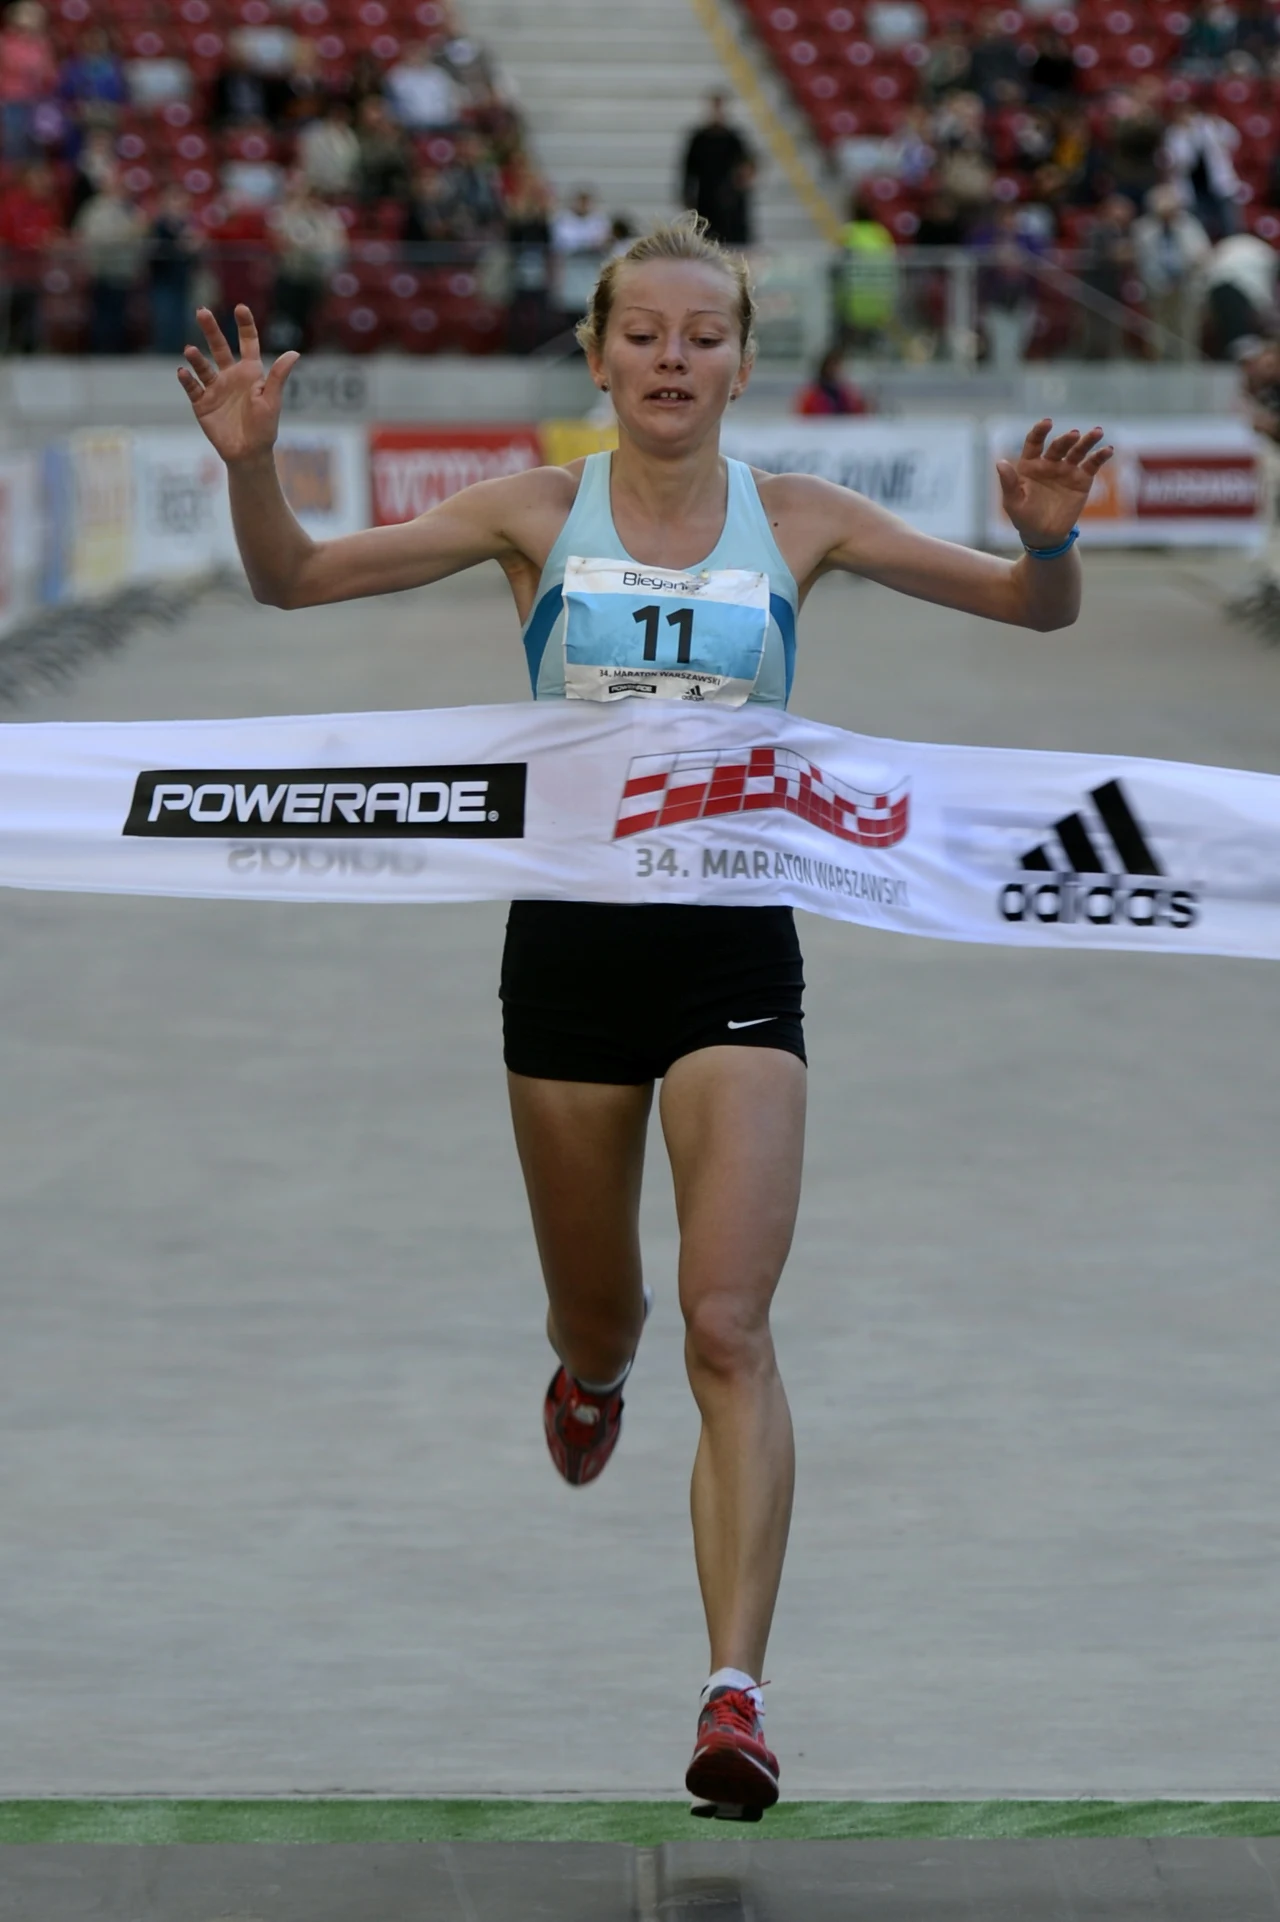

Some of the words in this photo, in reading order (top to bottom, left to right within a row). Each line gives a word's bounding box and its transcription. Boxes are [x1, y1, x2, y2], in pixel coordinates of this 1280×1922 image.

[632, 604, 694, 664] 11
[599, 669, 612, 678] 34.
[613, 669, 658, 679] MARATON
[659, 671, 721, 686] WARSZAWSKI
[148, 780, 490, 823] POWERADE
[636, 848, 690, 878] 34.
[702, 848, 814, 887] MARATON
[999, 872, 1202, 928] adidas
